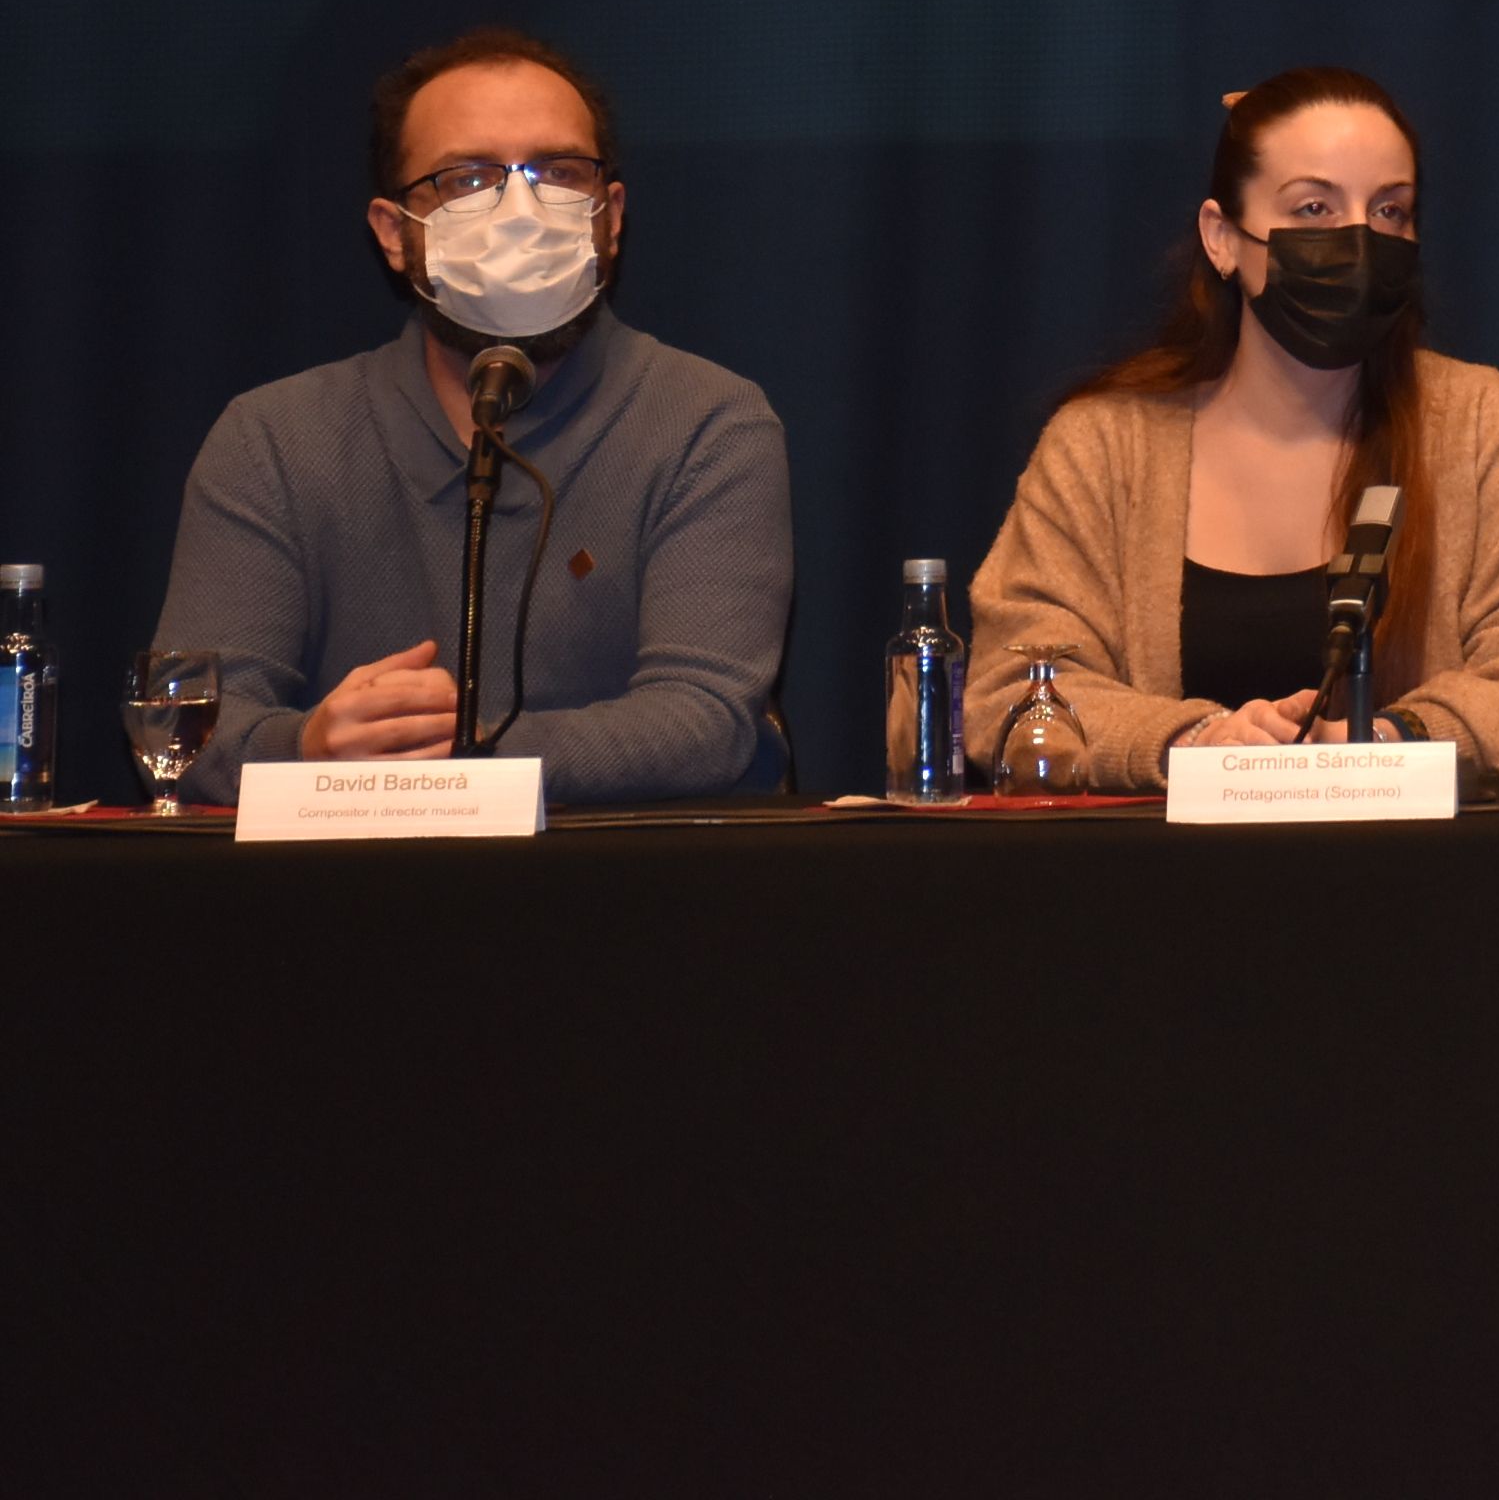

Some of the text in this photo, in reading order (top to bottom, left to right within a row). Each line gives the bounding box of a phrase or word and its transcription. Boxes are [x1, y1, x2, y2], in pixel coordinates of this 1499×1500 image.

[1221, 751, 1405, 771] Carmina Sánchez
[315, 774, 377, 792] David
[1222, 785, 1402, 803] Protagonista (Soprano)
[297, 806, 370, 820] Compositor
[380, 805, 428, 817] director
[431, 805, 480, 817] musical
